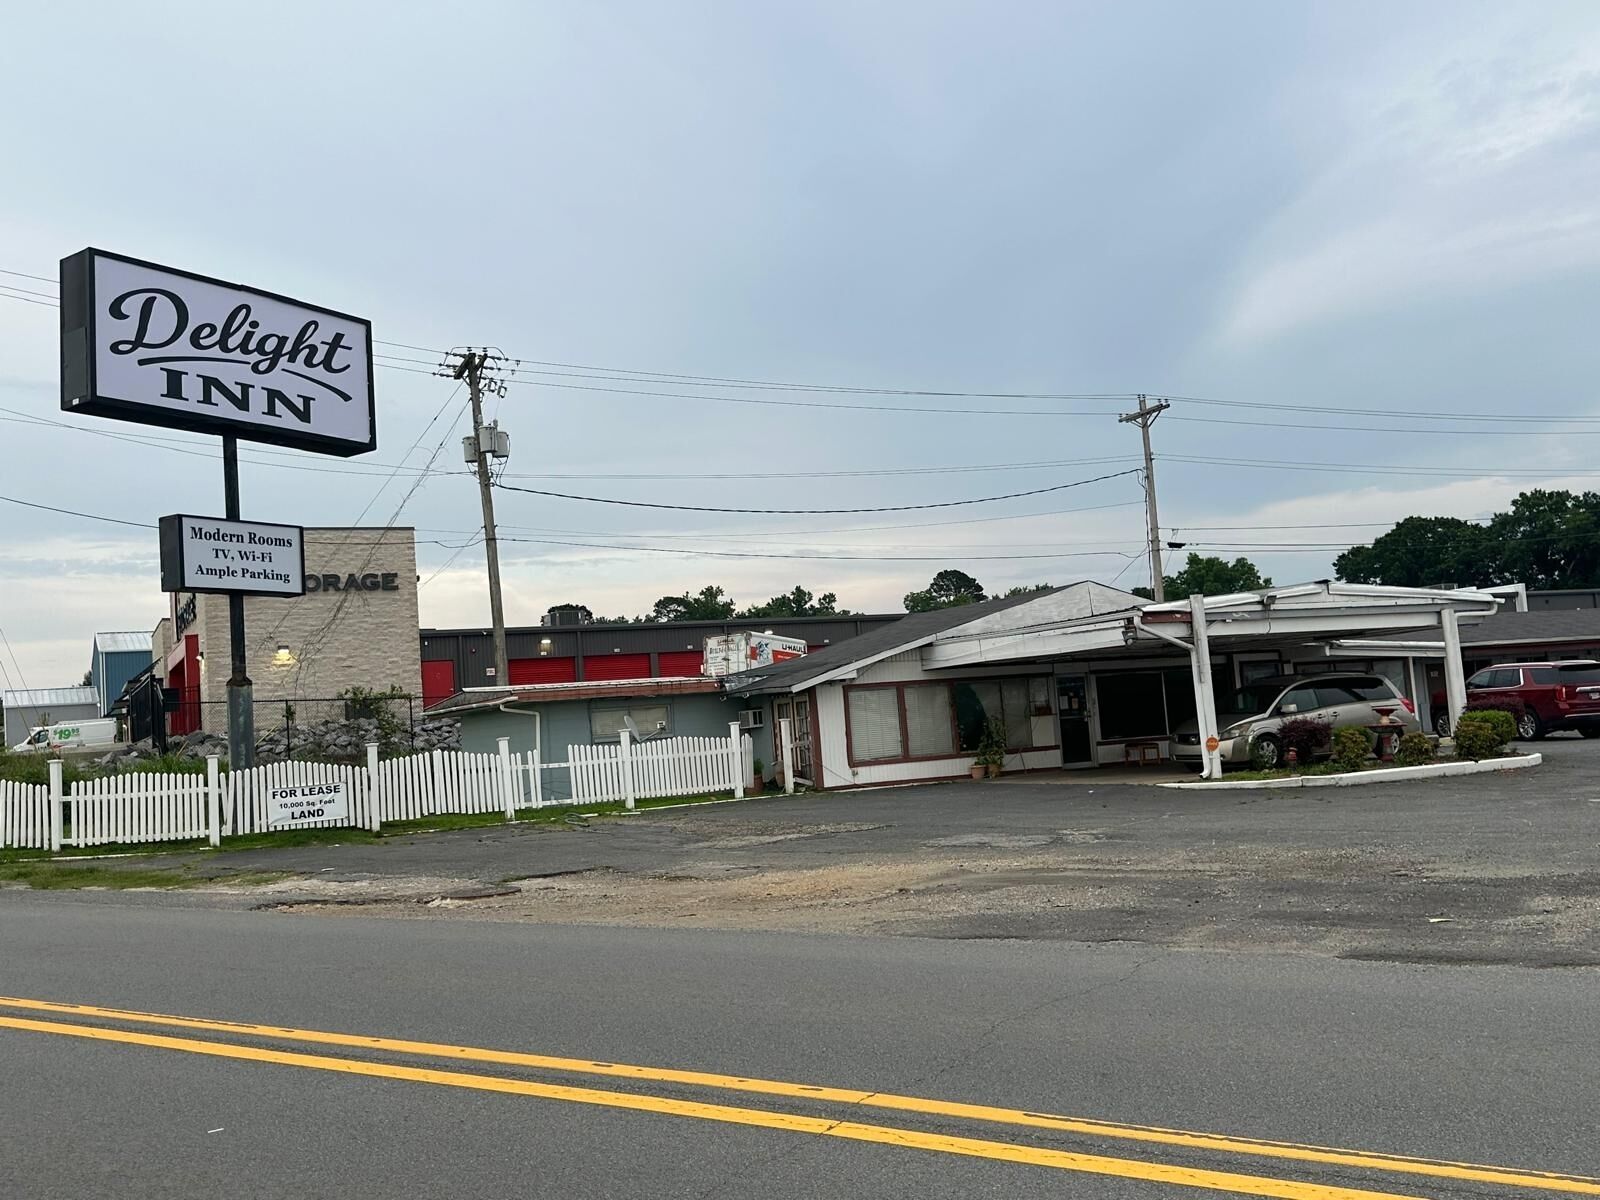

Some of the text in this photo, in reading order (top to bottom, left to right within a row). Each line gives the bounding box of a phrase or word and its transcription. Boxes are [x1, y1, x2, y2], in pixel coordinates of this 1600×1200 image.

[108, 287, 353, 375] Delight
[160, 367, 316, 424] INN
[190, 526, 293, 548] Modern Rooms
[212, 548, 273, 563] TV, Wi-Fi
[195, 564, 291, 584] Ample Parking
[272, 784, 341, 800] FOR LEASE
[280, 801, 304, 809] 10,000
[305, 800, 318, 808] Sq.
[291, 808, 325, 820] LAND
